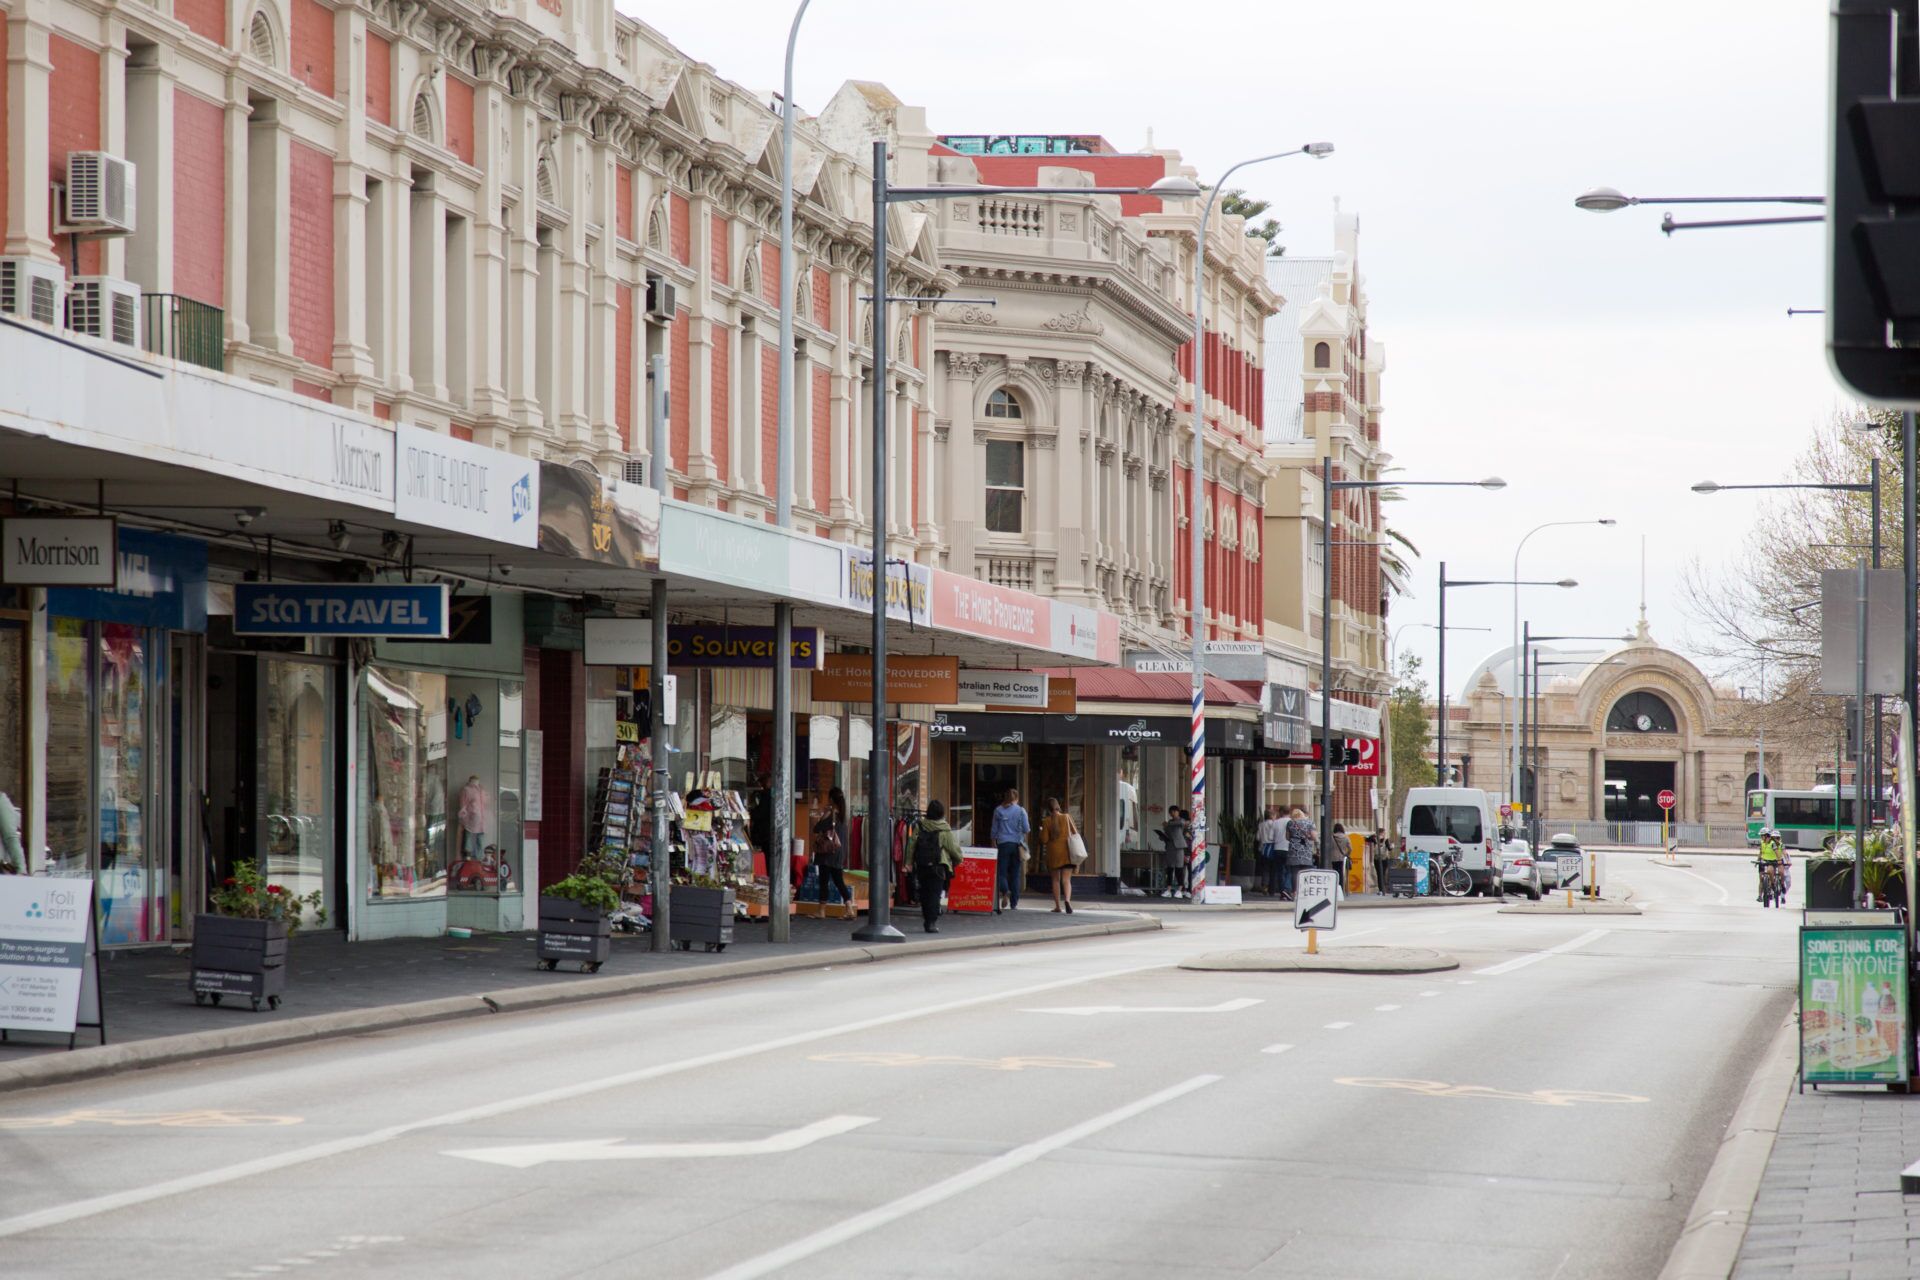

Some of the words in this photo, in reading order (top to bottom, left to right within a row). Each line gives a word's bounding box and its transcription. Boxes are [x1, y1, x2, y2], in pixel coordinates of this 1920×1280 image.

[331, 421, 382, 493] Morrison
[17, 536, 100, 566] Morrison
[252, 594, 300, 623] sta
[305, 599, 429, 625] TRAVEL
[953, 585, 970, 619] THE
[971, 589, 993, 626] HOME
[994, 596, 1035, 635] PROVEDORE
[1213, 644, 1257, 652] CANTONMENT
[820, 668, 842, 676] THE
[845, 668, 873, 677] HOM
[1145, 661, 1184, 672] LEAKE
[993, 682, 1011, 691] Red
[1013, 683, 1039, 693] Cross
[1109, 729, 1161, 738] nvmen
[1659, 796, 1675, 804] STOP
[50, 889, 75, 905] foli
[1303, 887, 1329, 897] LEFT
[47, 907, 77, 921] sim
[1, 943, 16, 951] The
[17, 944, 66, 954] non-surgical
[1807, 939, 1872, 954] SOMETHING
[1875, 939, 1899, 953] FOR
[0, 952, 25, 961] olution
[27, 953, 35, 962] to
[36, 954, 53, 963] hair
[53, 955, 70, 965] loss
[1807, 955, 1899, 976] EVERYONE
